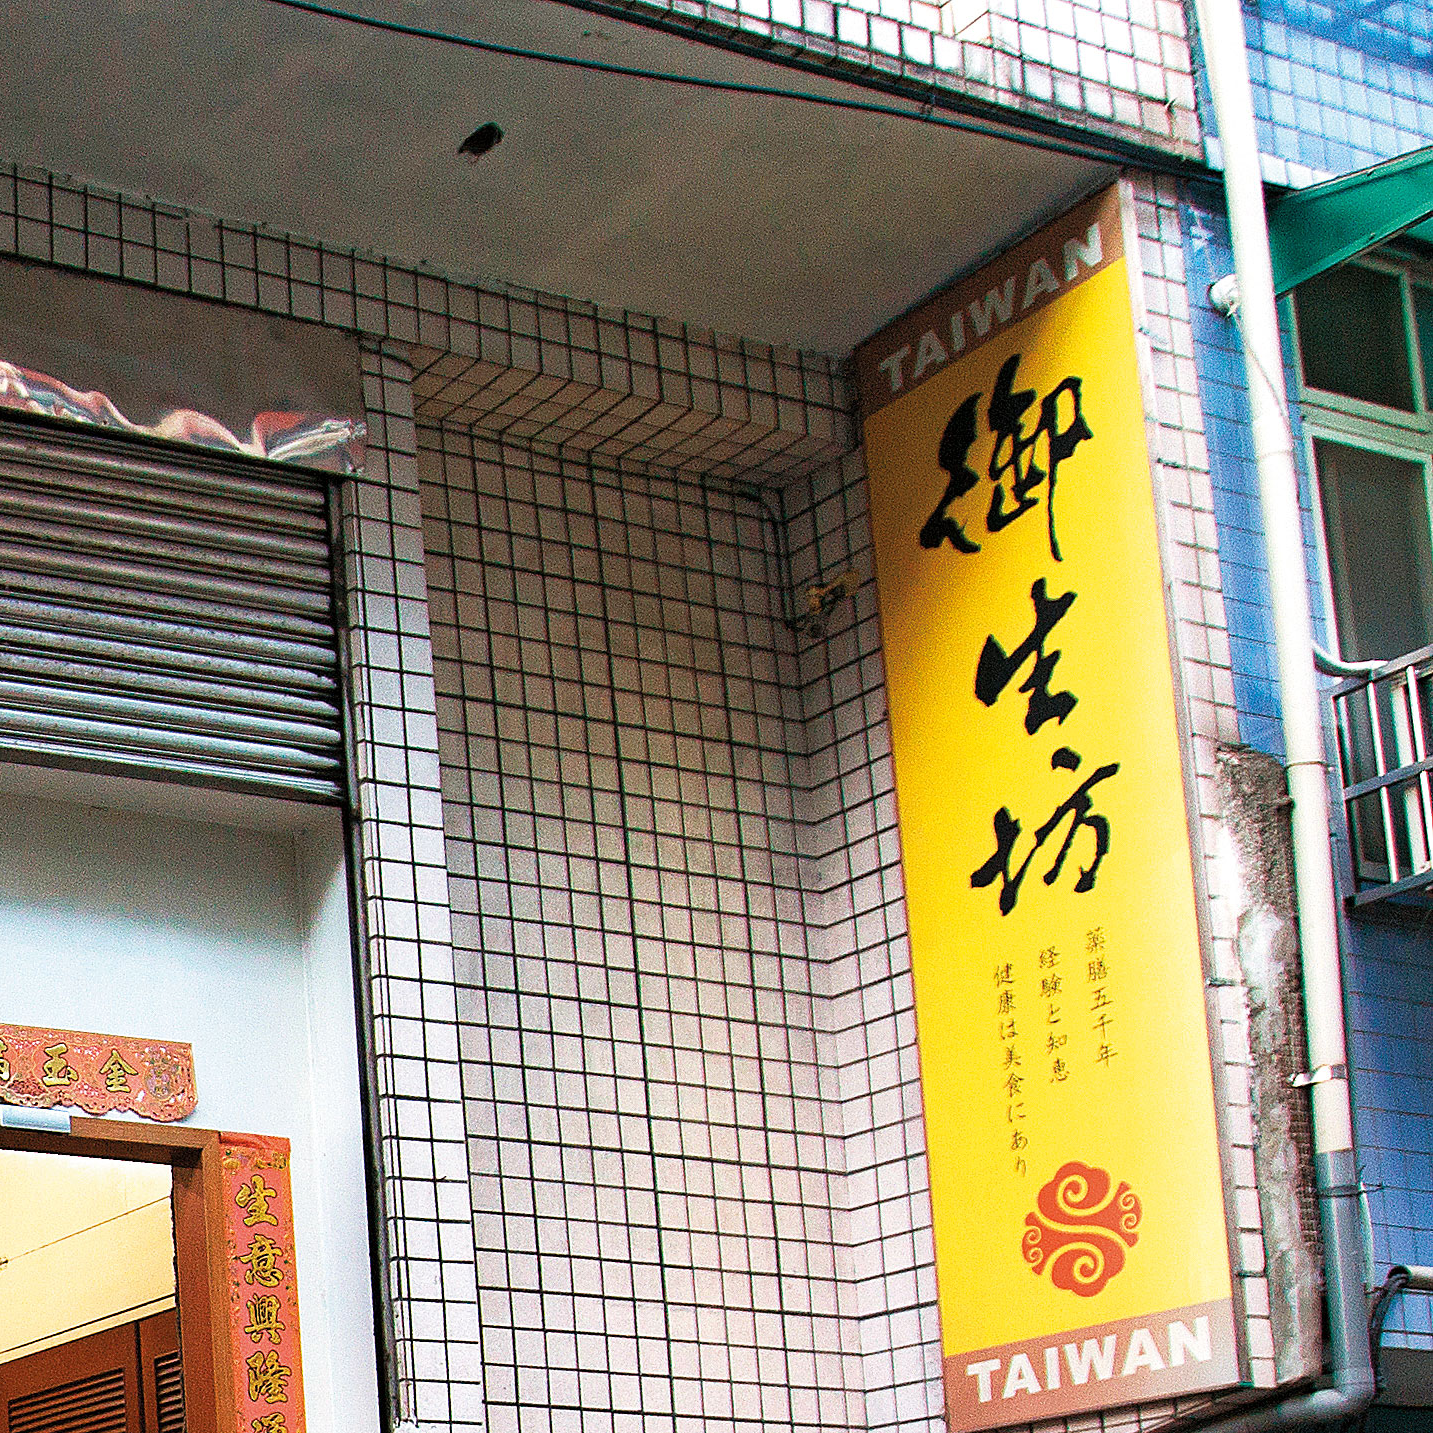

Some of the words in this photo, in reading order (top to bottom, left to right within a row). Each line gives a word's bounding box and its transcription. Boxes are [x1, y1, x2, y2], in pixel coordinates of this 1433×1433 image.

[878, 221, 1105, 393] TAIWAN
[919, 352, 1121, 917] 御生坊
[966, 1315, 1213, 1404] TAIWAN
